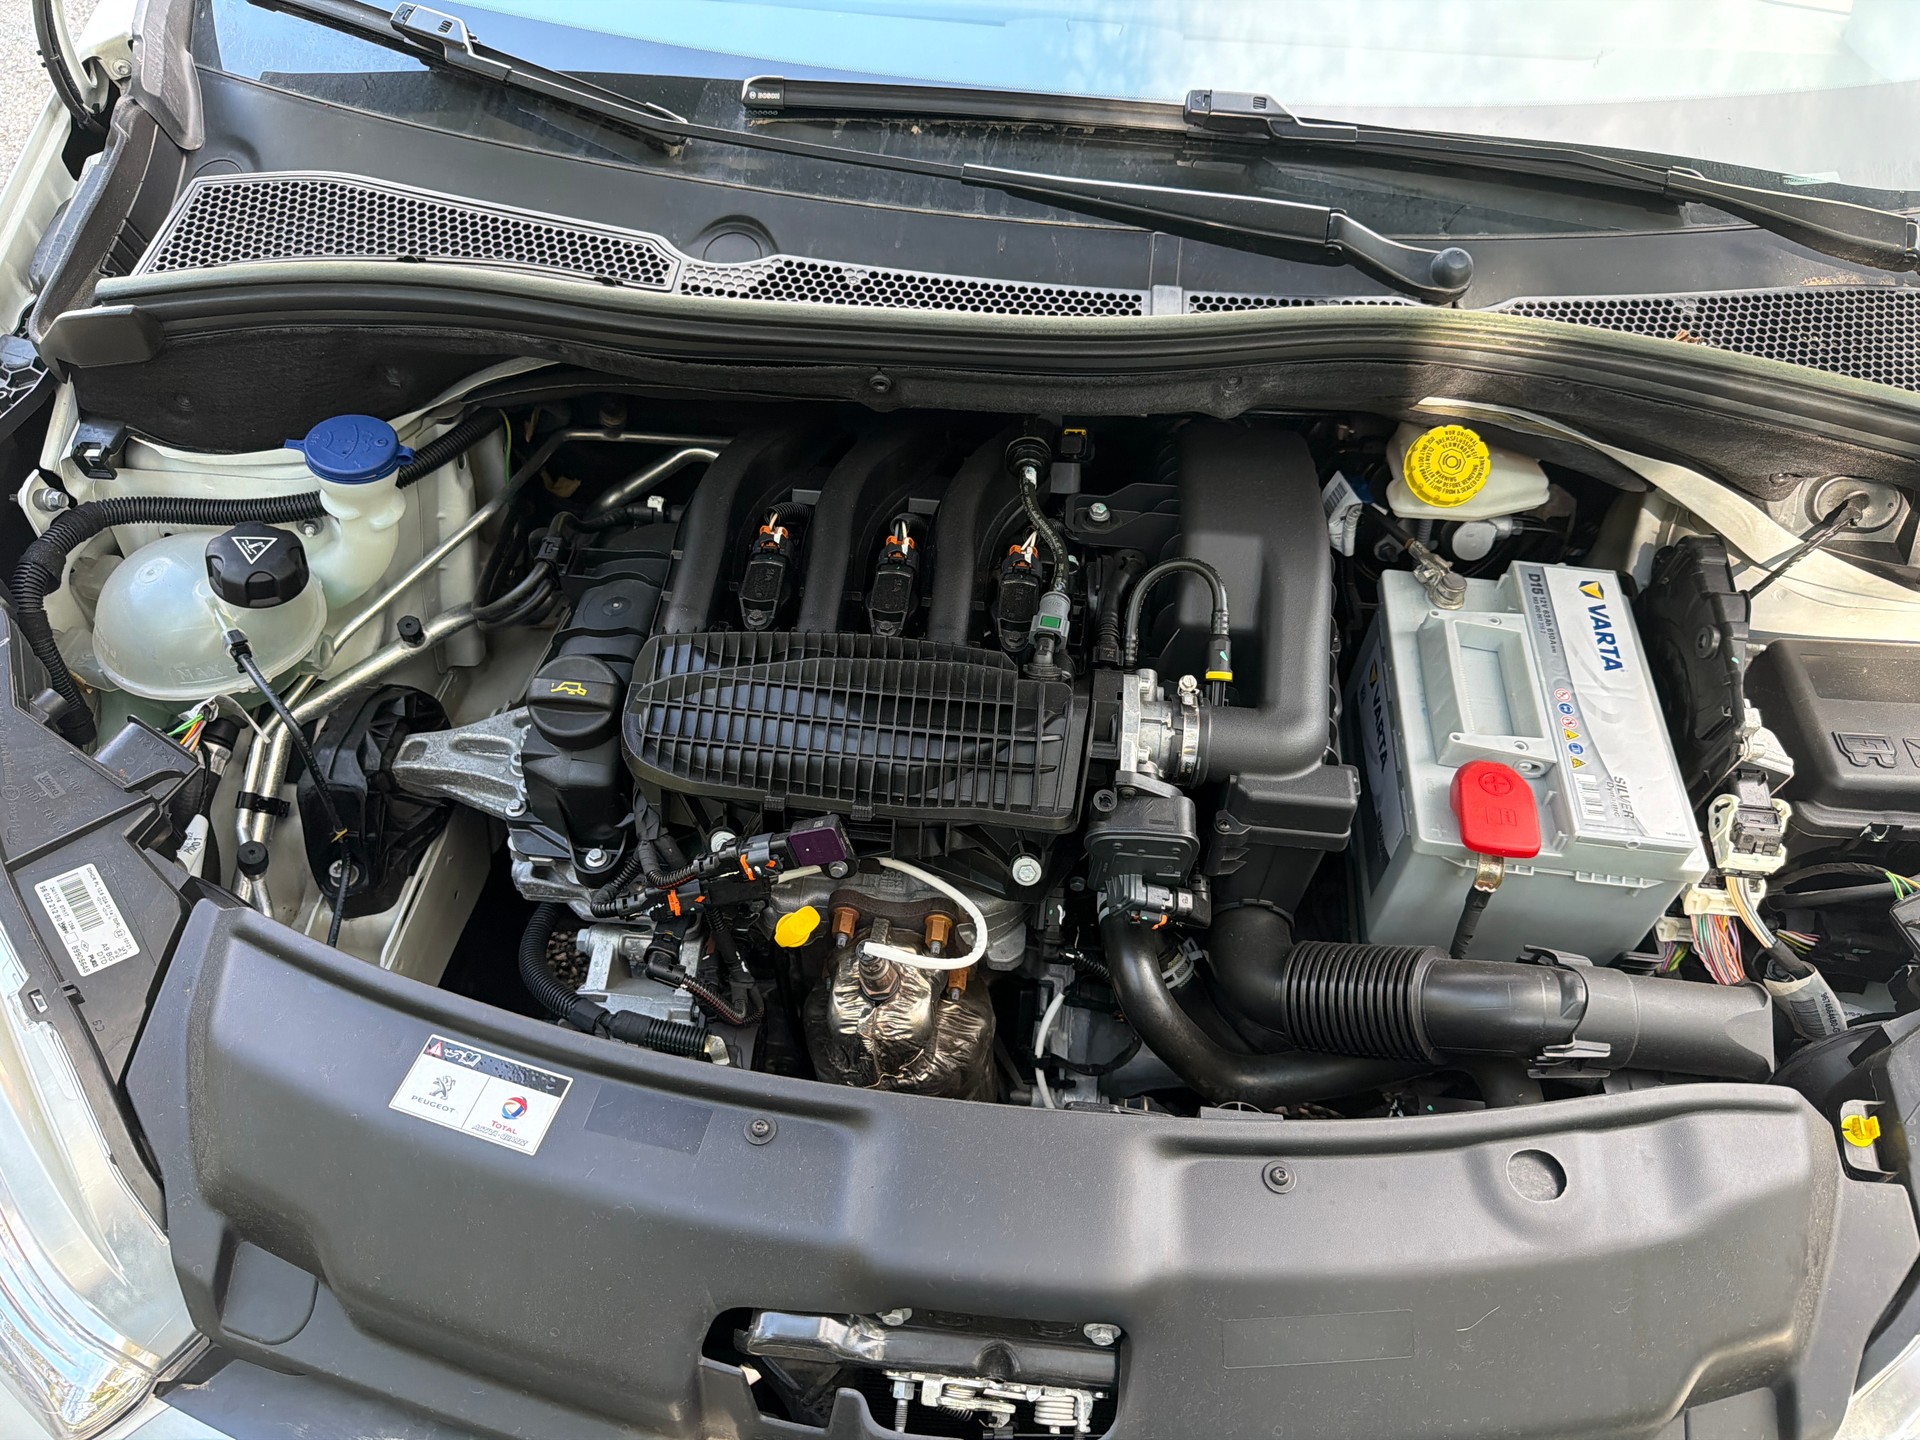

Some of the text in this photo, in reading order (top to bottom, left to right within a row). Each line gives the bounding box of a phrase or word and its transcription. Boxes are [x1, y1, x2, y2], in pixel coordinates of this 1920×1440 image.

[757, 92, 780, 100] BOSCH
[1457, 431, 1479, 446] ORIGINAL
[1425, 447, 1434, 461] CLEAN
[1426, 463, 1435, 479] FILLER
[1420, 469, 1430, 483] BRAKE
[1429, 481, 1442, 492] FLUID
[1461, 480, 1477, 493] SEALED
[1528, 573, 1544, 595] D15
[1540, 596, 1549, 609] 12V
[1588, 604, 1623, 671] VARTA
[1373, 684, 1388, 773] VARTA
[1614, 776, 1635, 819] SILVER
[44, 893, 52, 903] 022
[49, 904, 58, 914] 212
[102, 943, 115, 961] A9 BG
[411, 1095, 456, 1114] PEUGEOT
[491, 1120, 518, 1135] TOTAL
